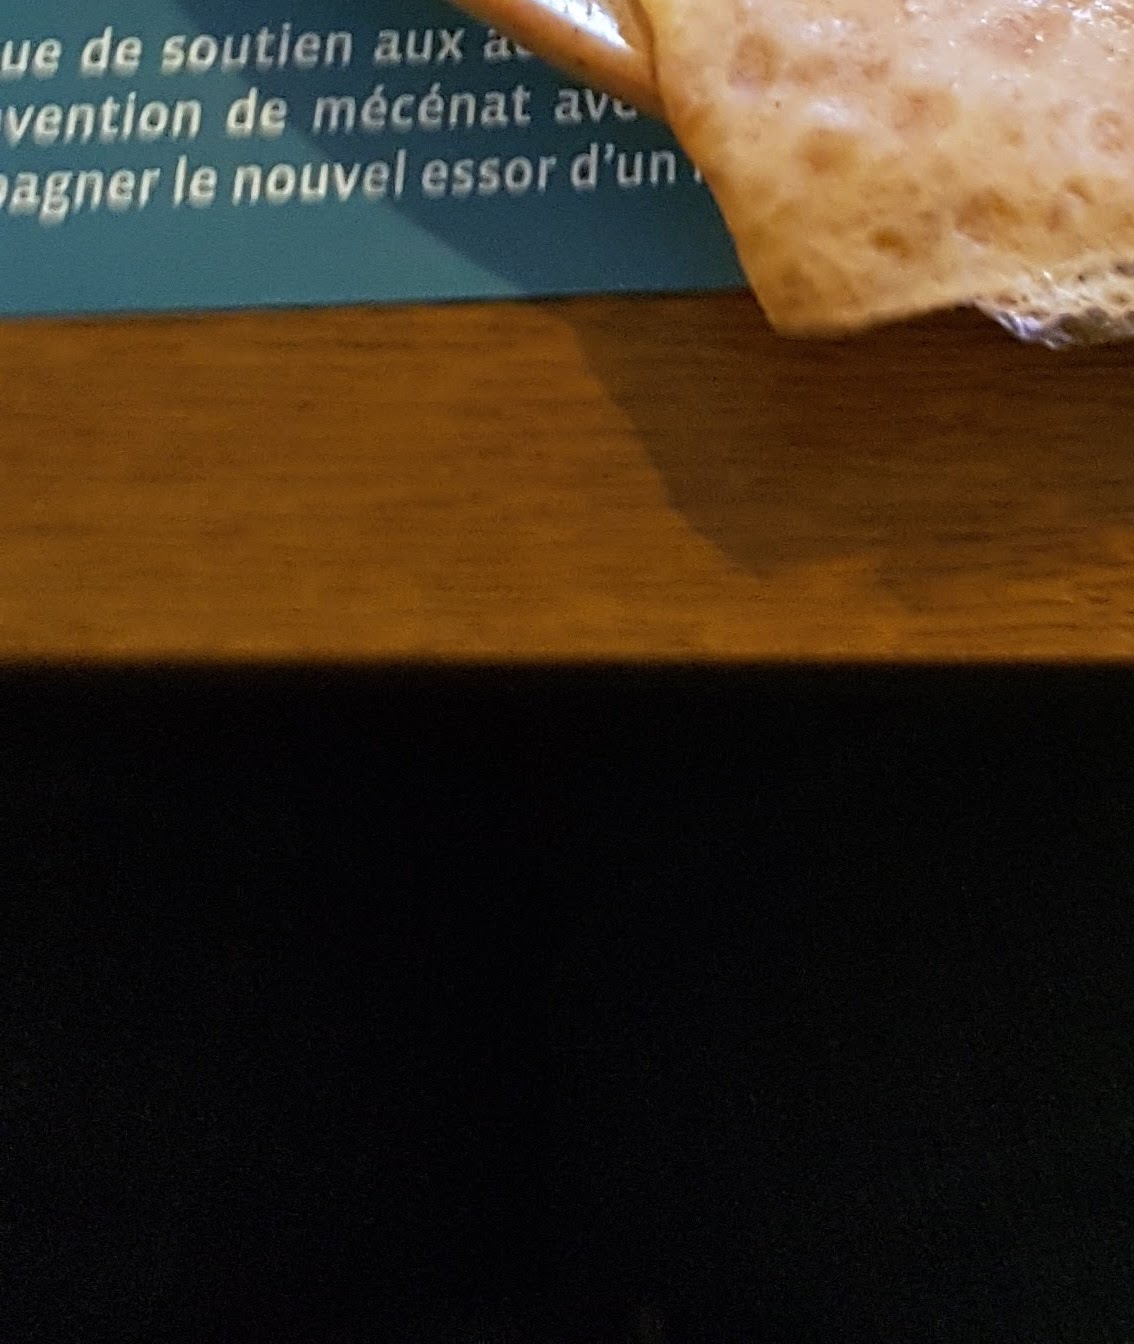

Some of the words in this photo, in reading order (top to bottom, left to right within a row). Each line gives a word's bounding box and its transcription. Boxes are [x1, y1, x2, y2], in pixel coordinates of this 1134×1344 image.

[82, 25, 144, 75] de
[161, 22, 353, 74] soutien
[373, 28, 464, 65] aux
[4, 91, 202, 145] vention
[227, 86, 289, 138] de
[312, 82, 532, 134] mécénat
[174, 153, 218, 209] le
[233, 148, 407, 205] nouvel
[420, 155, 558, 198] essor
